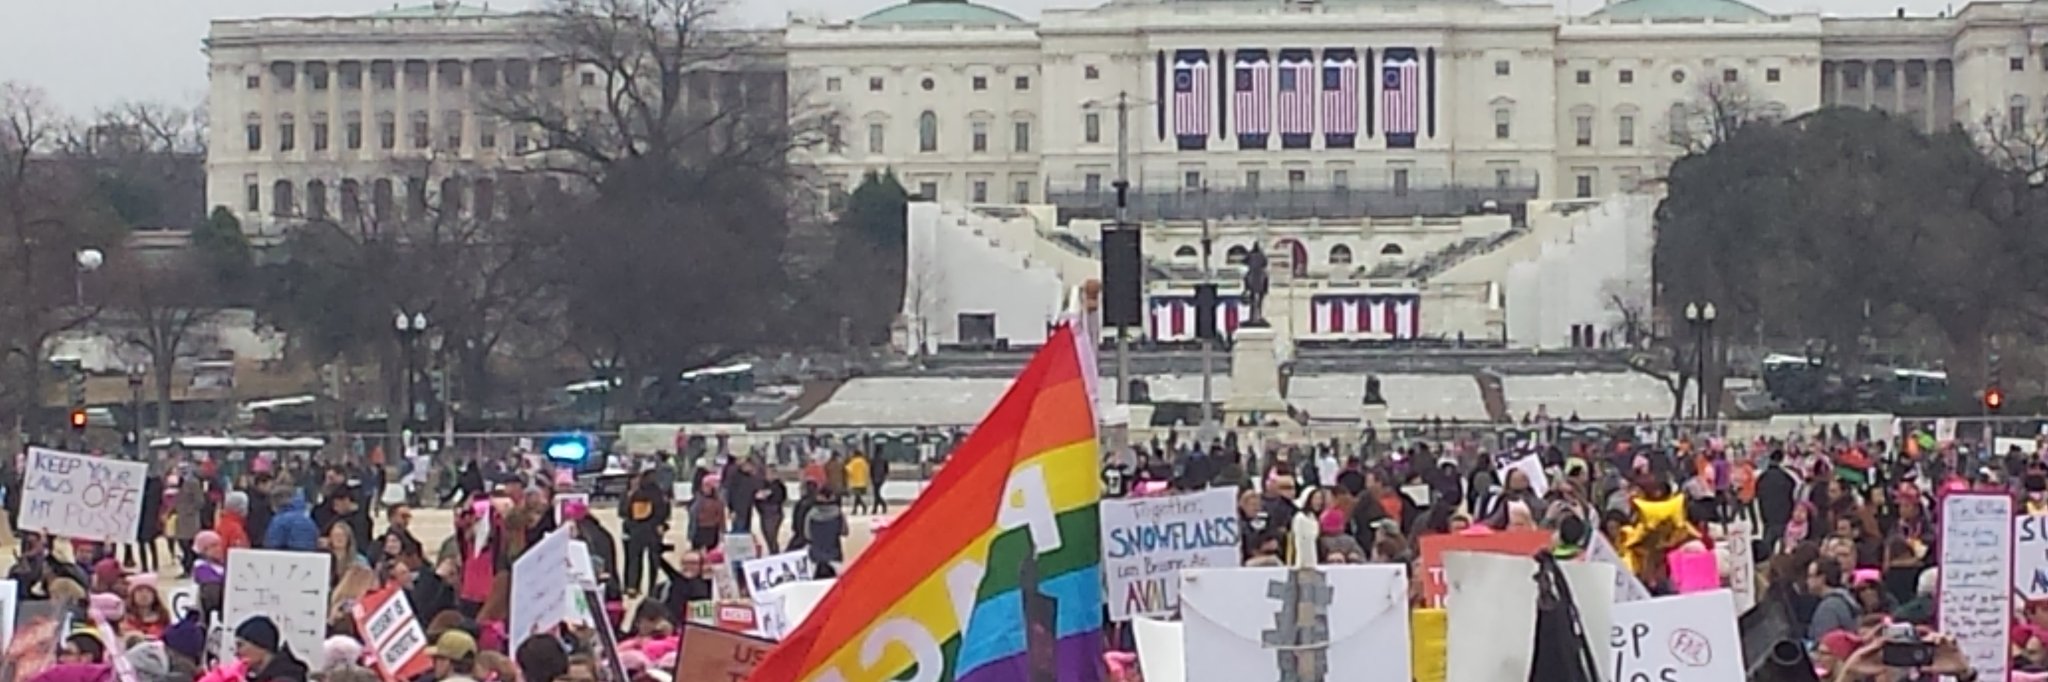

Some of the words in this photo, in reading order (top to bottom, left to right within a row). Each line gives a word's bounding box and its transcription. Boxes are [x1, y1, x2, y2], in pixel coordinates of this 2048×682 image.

[34, 452, 80, 474] KEEP
[82, 483, 139, 513] OFF
[1107, 516, 1240, 558] SNOWFLAKES
